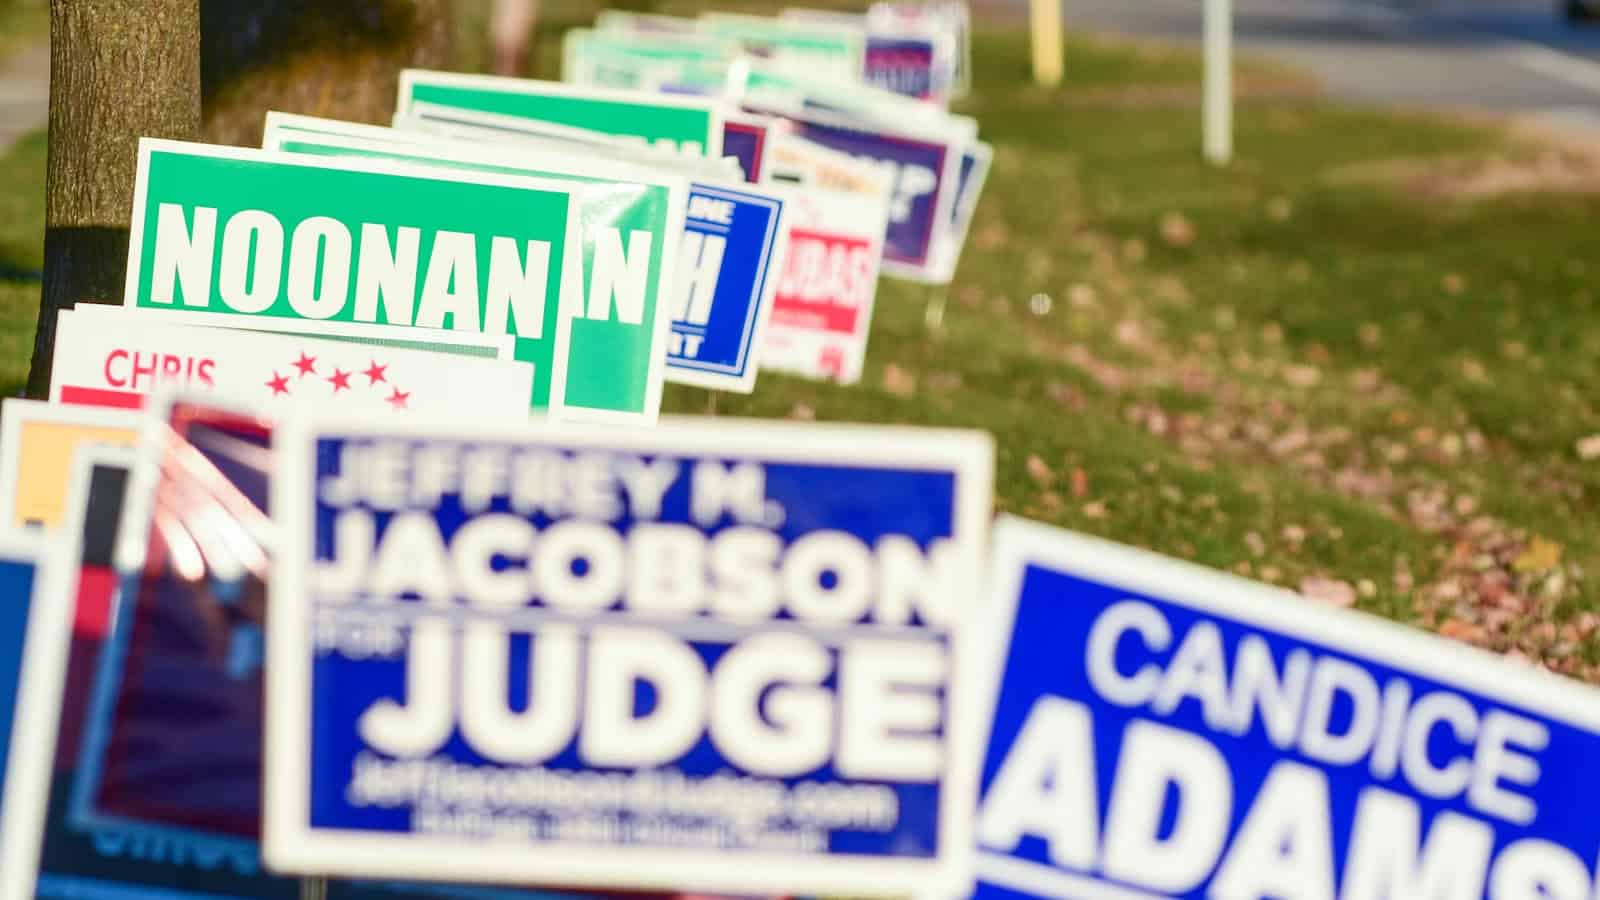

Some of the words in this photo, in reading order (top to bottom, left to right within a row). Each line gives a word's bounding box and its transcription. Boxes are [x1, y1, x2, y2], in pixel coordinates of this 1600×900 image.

[150, 203, 550, 340] NOONAN
[103, 348, 216, 391] CHRIS
[318, 440, 679, 522] JEFFREY
[690, 458, 787, 528] M.
[309, 508, 960, 626] JACOBSON
[357, 618, 948, 782] JUDGE
[1084, 598, 1550, 826] CANDICE
